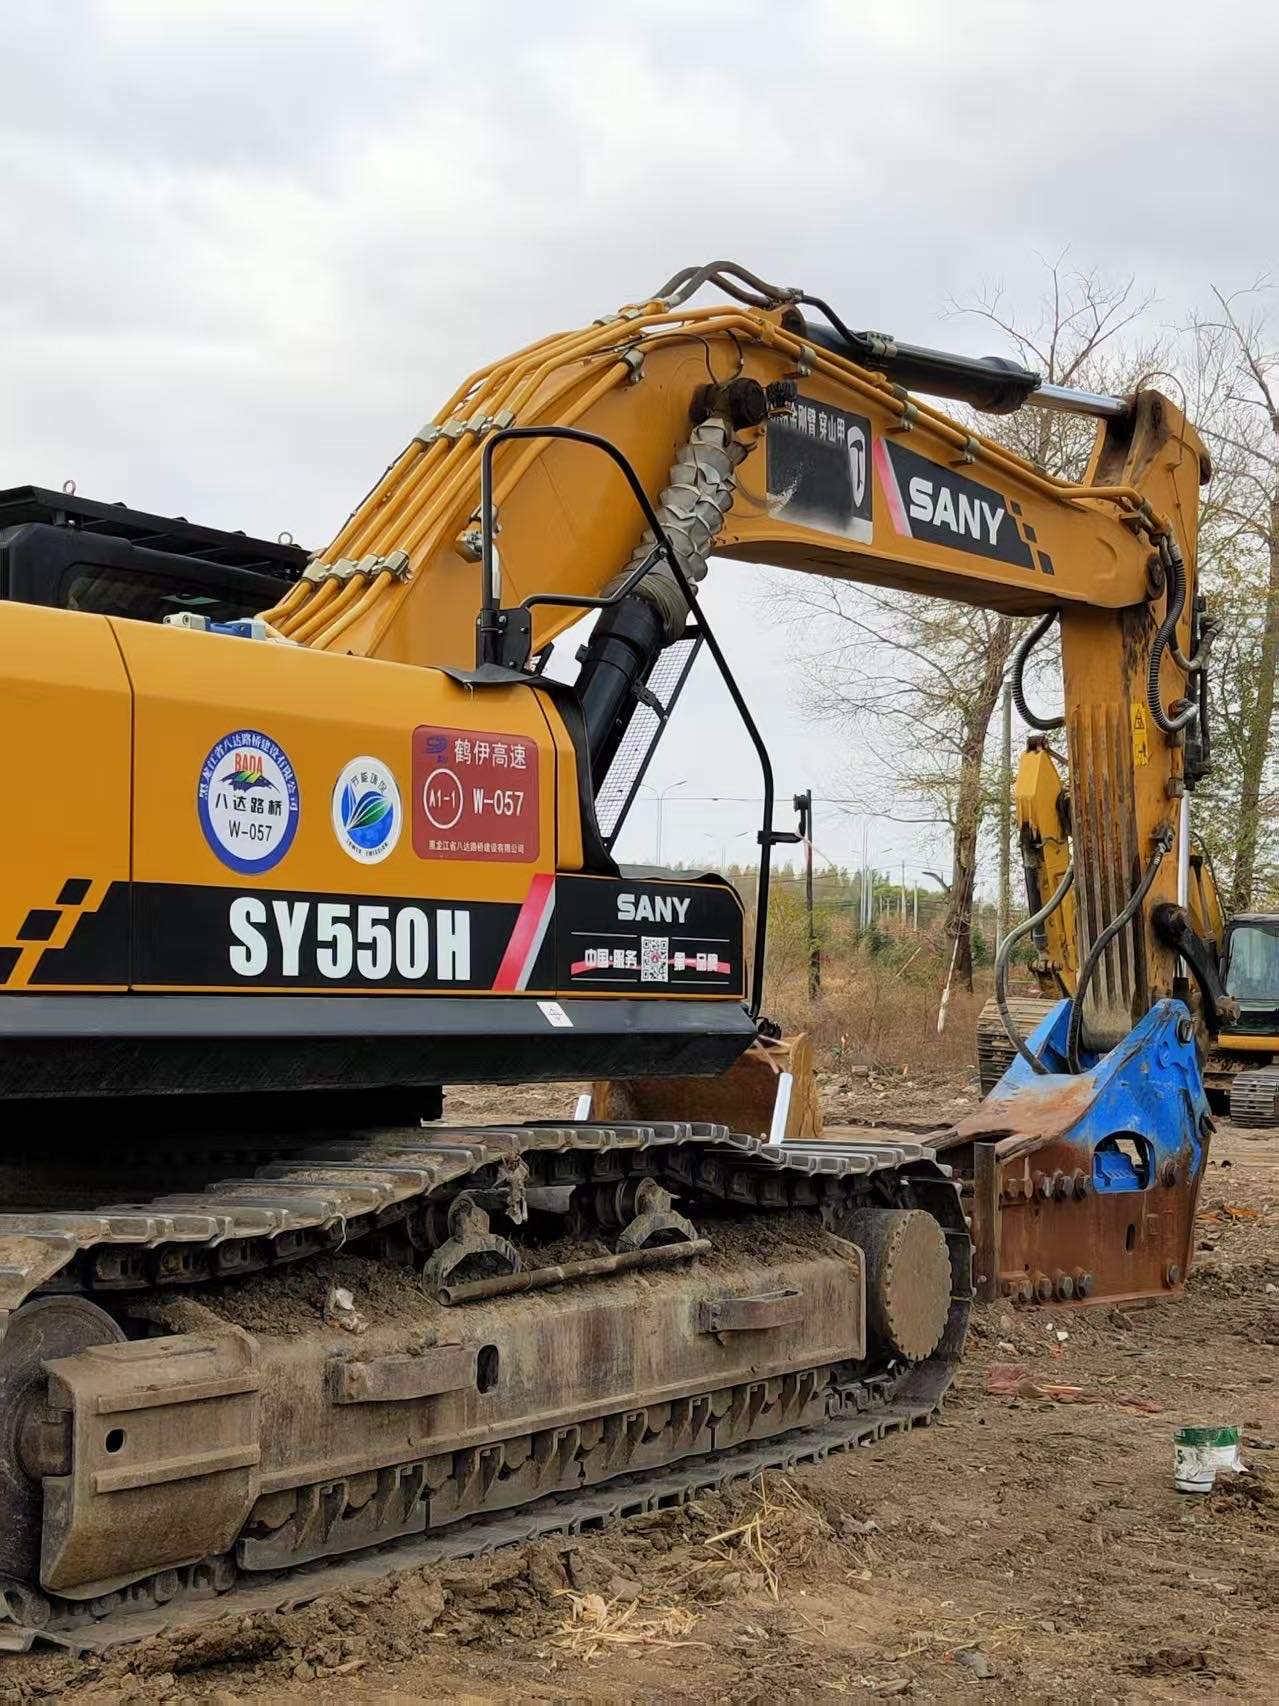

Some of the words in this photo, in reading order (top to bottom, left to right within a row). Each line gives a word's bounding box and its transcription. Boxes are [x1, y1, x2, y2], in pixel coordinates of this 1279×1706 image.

[909, 476, 1005, 546] SANY
[234, 752, 264, 774] BADA
[454, 738, 527, 769] 鹤伊高速
[215, 793, 283, 816] 八达路桥
[429, 788, 456, 809] A1-1
[473, 788, 525, 816] W-057
[228, 819, 273, 842] W-057
[428, 840, 525, 854] 黑龙江省八达路桥建设有限公司
[616, 893, 691, 924] SANY
[229, 896, 471, 981] SY550H
